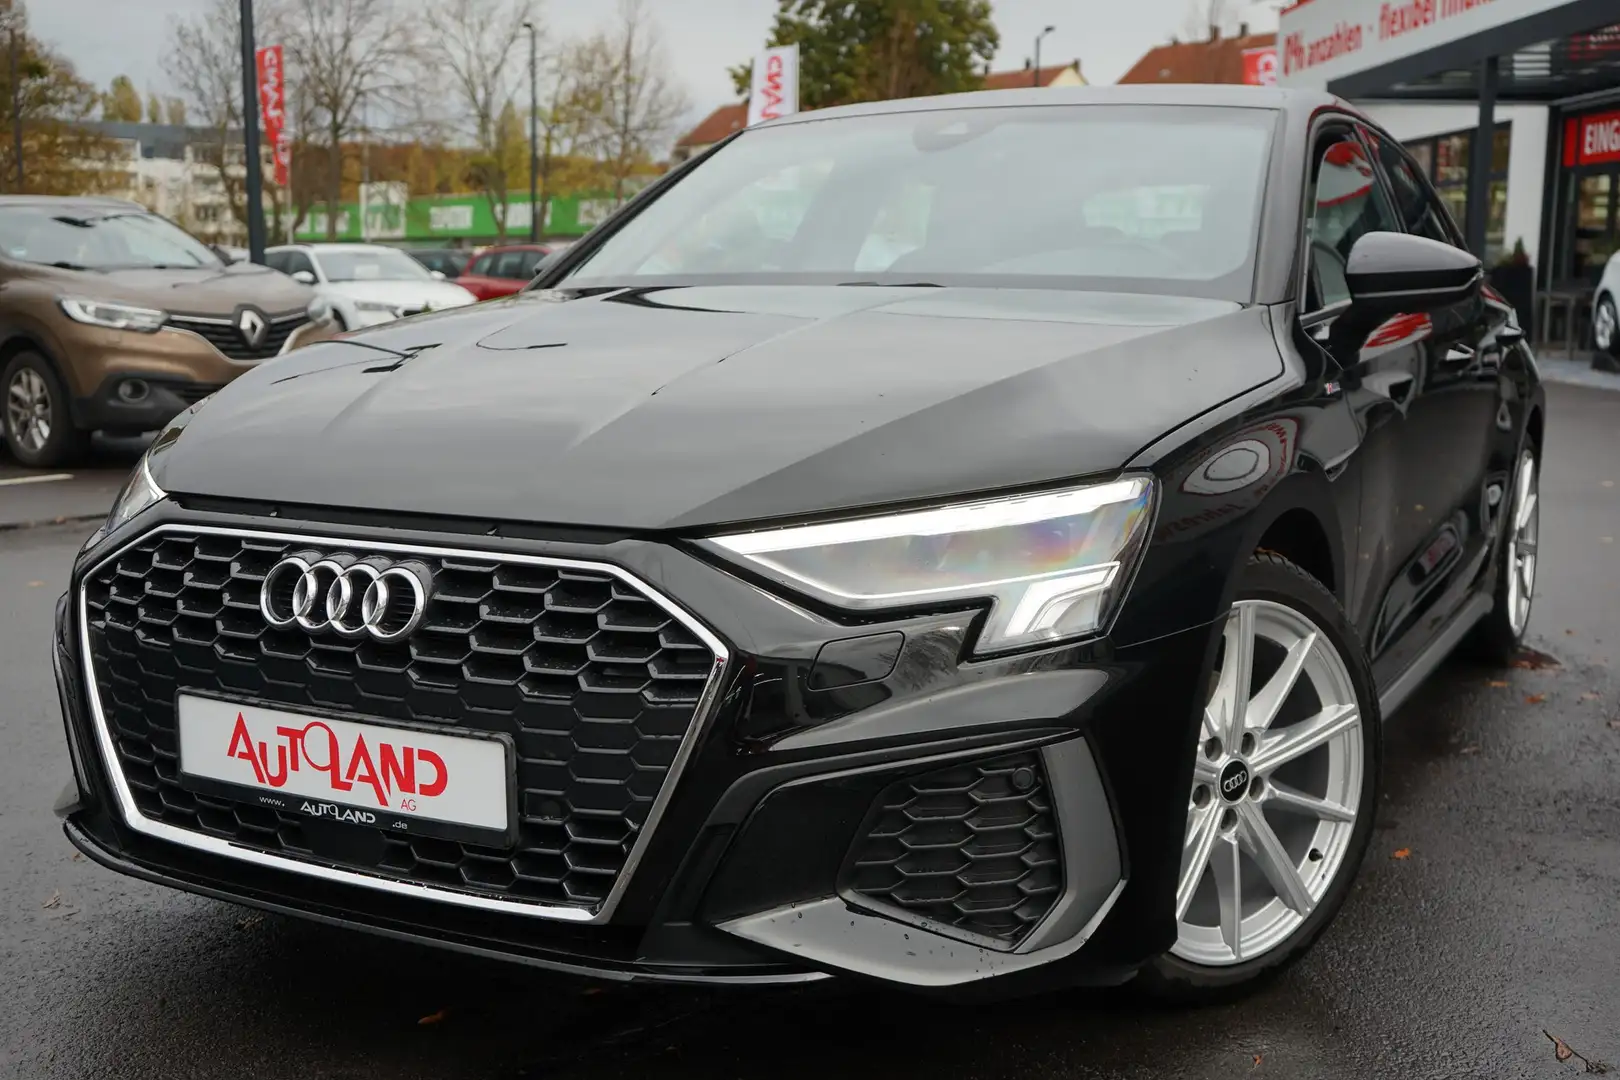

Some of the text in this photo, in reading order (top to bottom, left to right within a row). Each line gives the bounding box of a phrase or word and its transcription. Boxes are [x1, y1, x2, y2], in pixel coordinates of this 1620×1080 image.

[1307, 19, 1363, 68] anzahlen
[227, 711, 449, 806] AUTOLAND
[259, 796, 408, 830] www. AUTOLAND .de
[400, 799, 417, 812] AG
